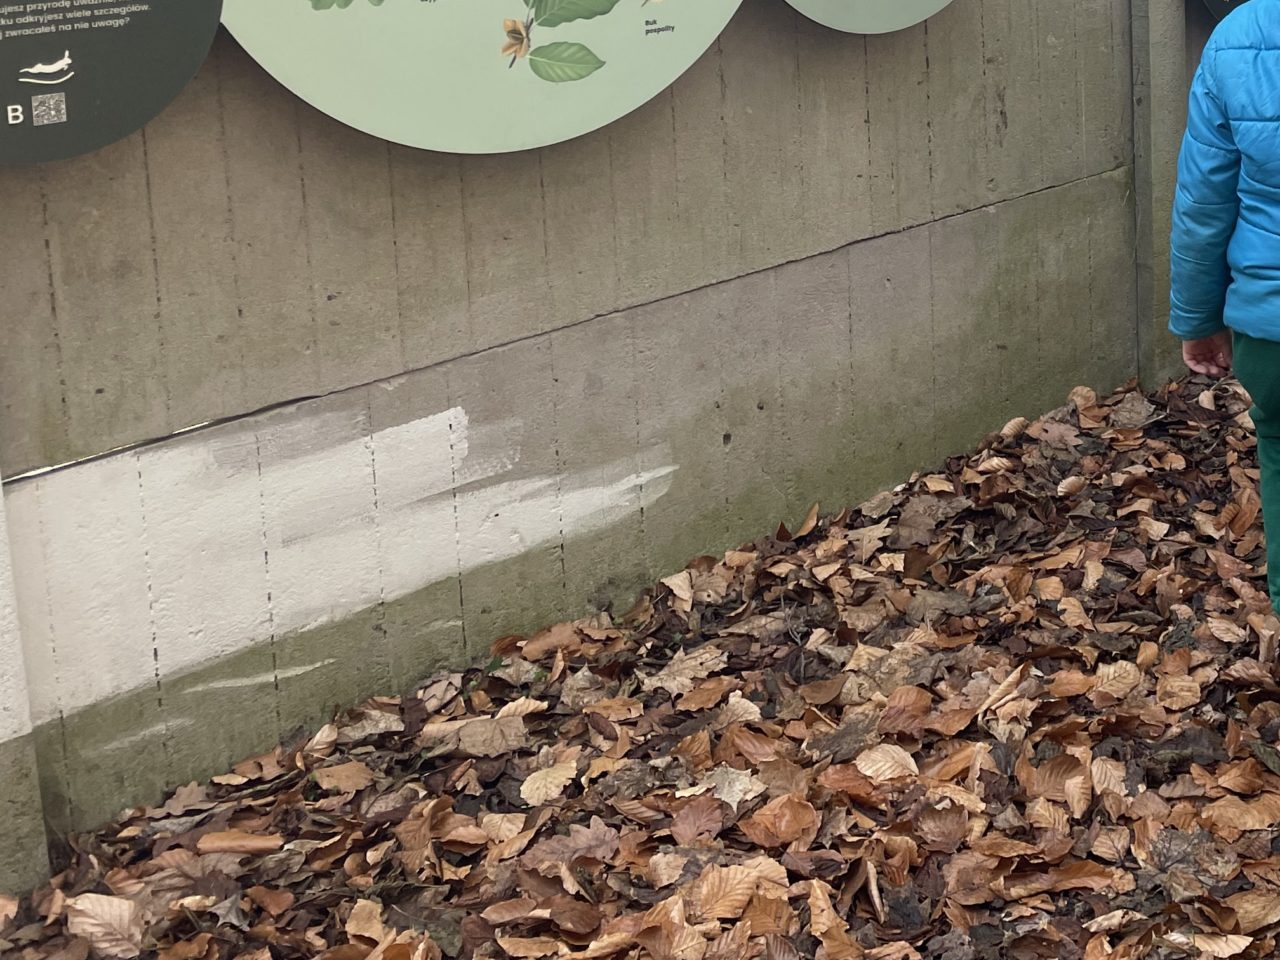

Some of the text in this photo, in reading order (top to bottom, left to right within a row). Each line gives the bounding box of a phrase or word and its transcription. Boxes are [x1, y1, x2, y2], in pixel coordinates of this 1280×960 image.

[15, 12, 63, 24] odkryjesz
[66, 8, 91, 19] wiele
[94, 3, 150, 16] szczegółów.
[5, 24, 56, 37] zwracałeś
[74, 21, 89, 31] nie
[92, 17, 129, 30] uwagę?
[645, 25, 675, 36] pospolity
[7, 105, 24, 124] B
